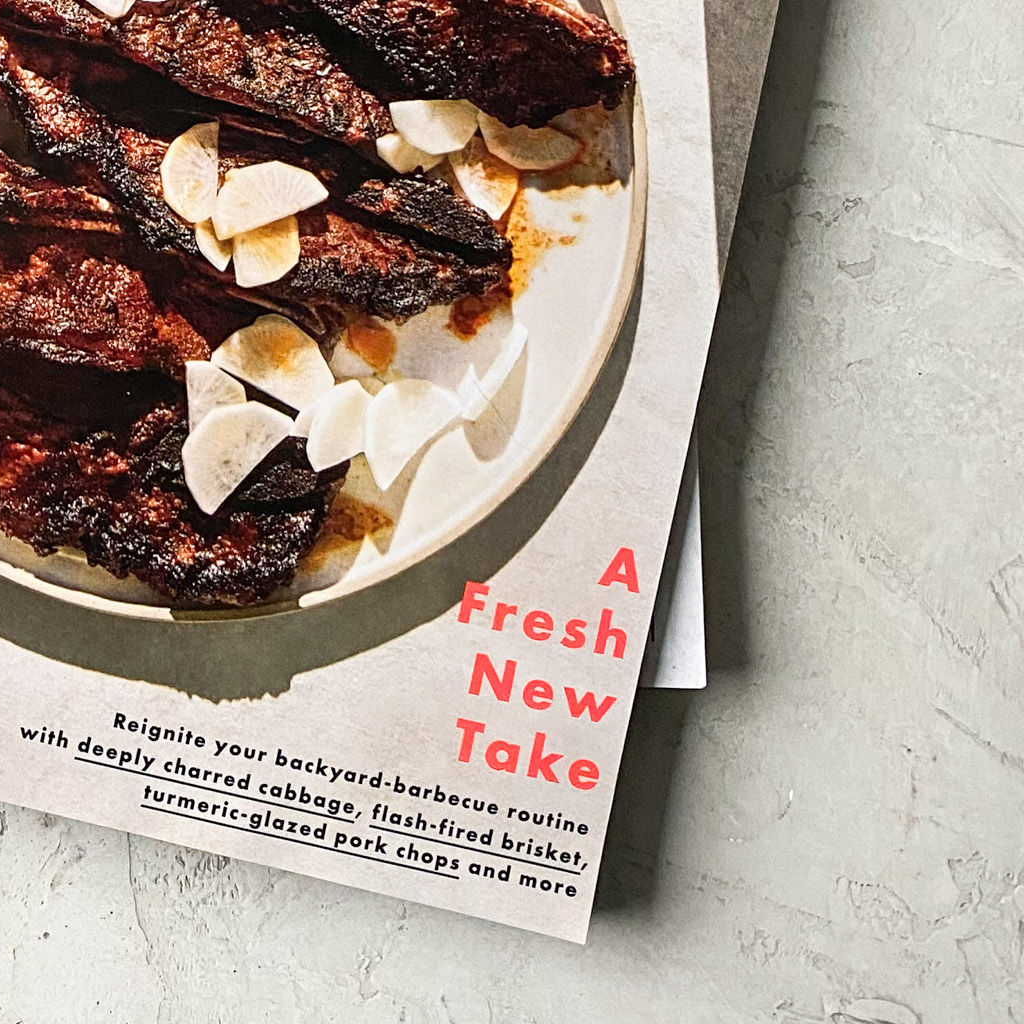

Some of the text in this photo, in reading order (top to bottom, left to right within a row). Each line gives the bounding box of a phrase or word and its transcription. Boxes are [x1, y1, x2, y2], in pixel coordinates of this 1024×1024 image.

[597, 547, 640, 594] A
[457, 580, 628, 659] Fresh
[468, 652, 617, 723] New
[113, 712, 589, 835] Reignite your backyard-barbecue routine
[456, 717, 600, 790] Take
[20, 726, 589, 871] with deeply charred cabbage, flash-fired brisket,
[143, 785, 578, 897] turmeric-glazed pork chops and more
